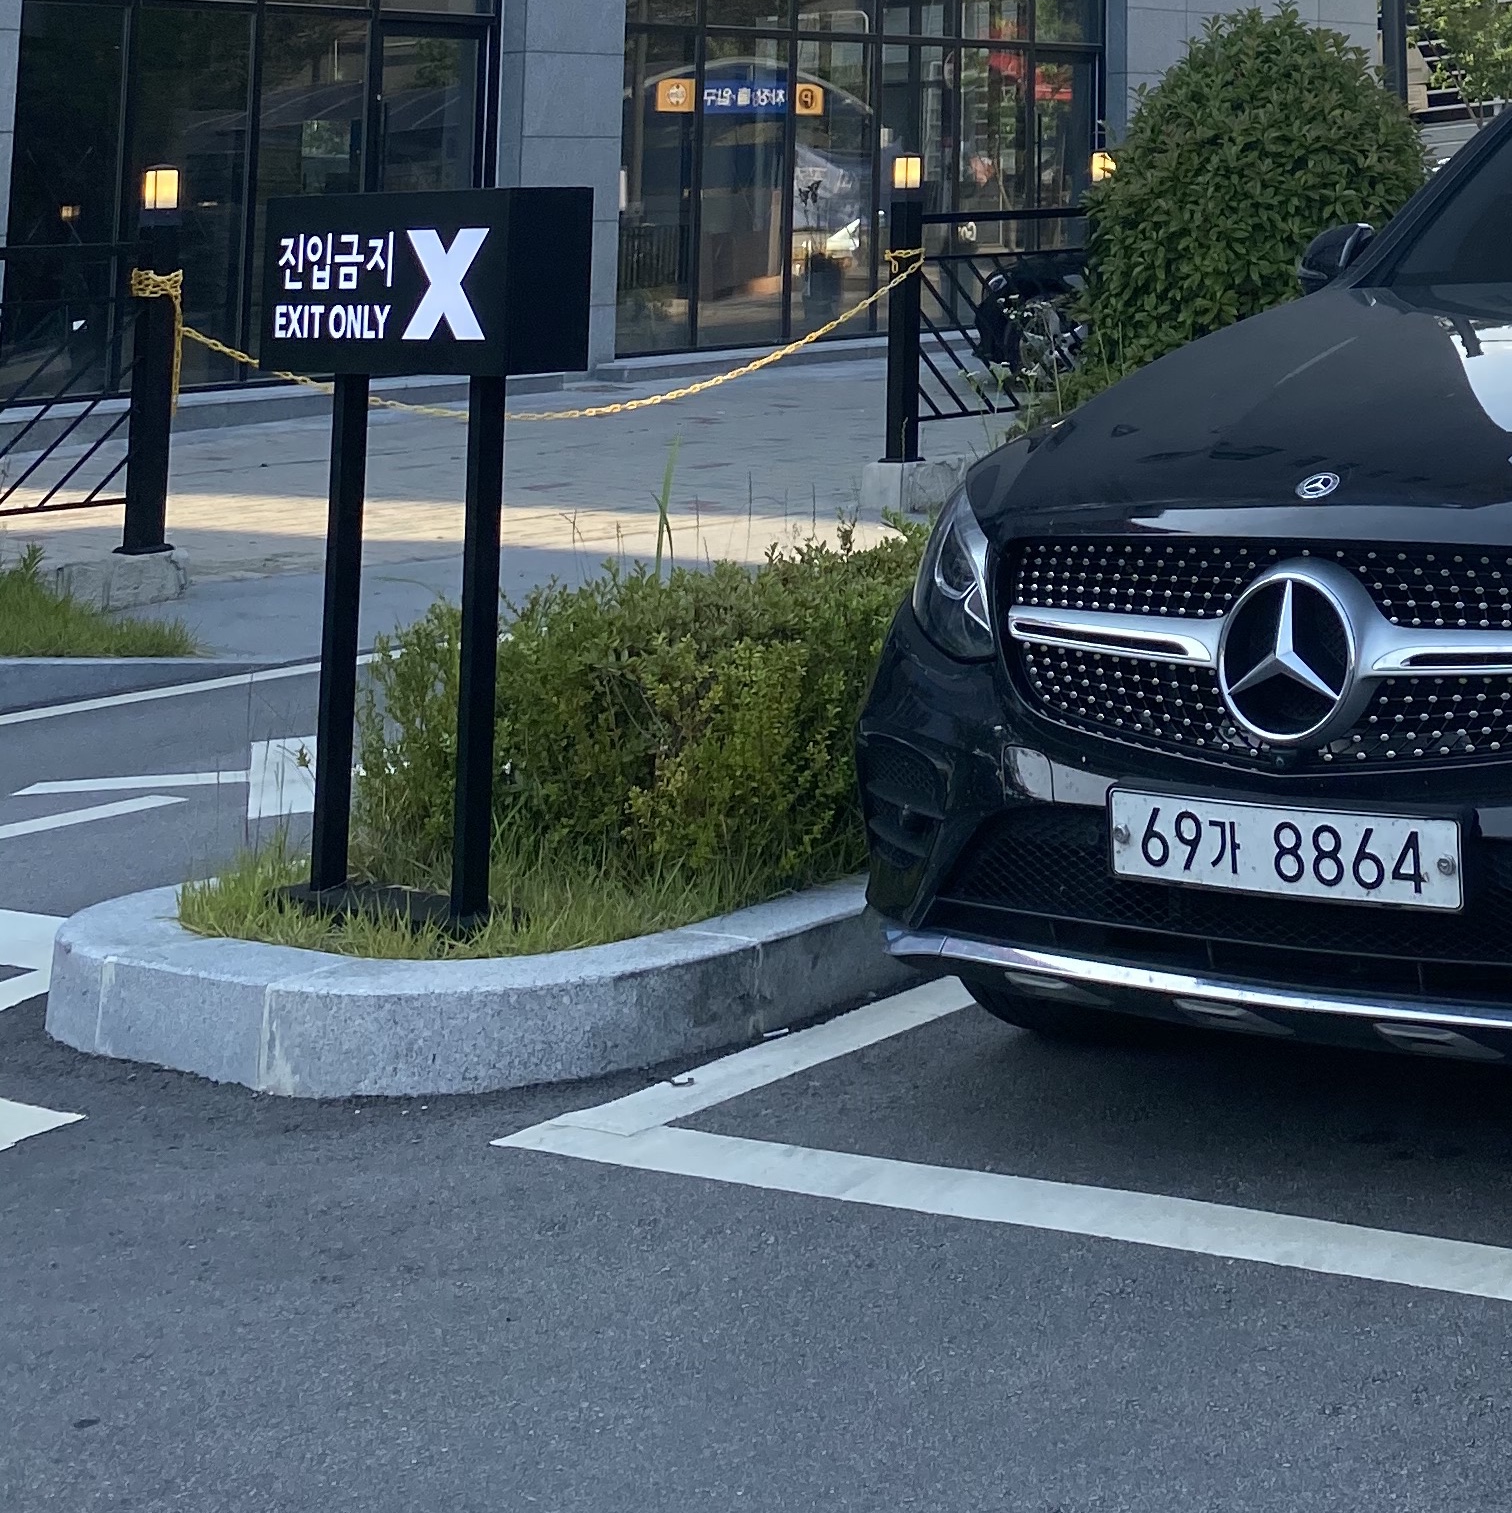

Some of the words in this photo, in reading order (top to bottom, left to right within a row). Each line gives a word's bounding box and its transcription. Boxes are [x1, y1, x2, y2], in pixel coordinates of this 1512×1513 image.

[278, 230, 395, 290] 진입금지
[274, 304, 325, 339] EXIT
[328, 304, 391, 339] ONLY
[1141, 807, 1240, 874] 69가
[1273, 821, 1428, 895] 8864
